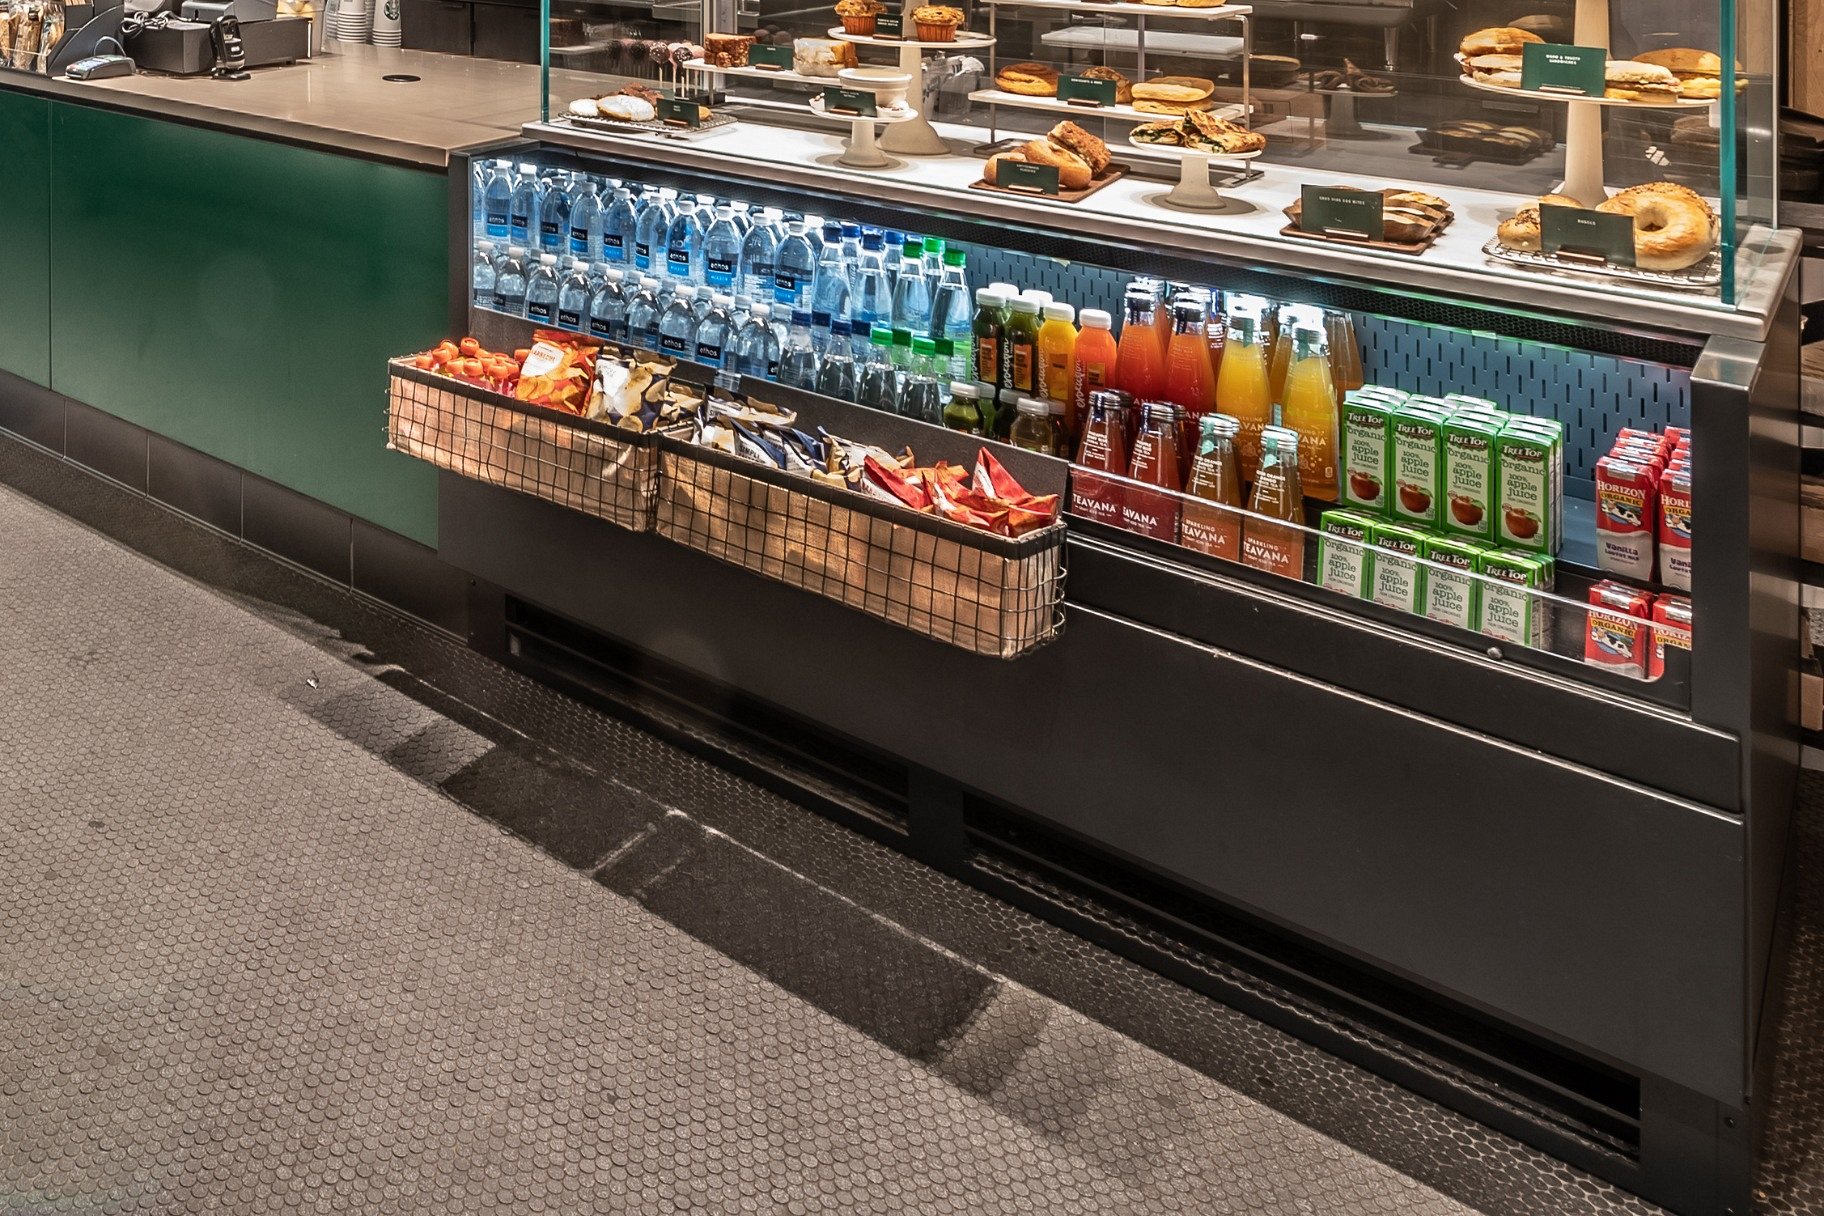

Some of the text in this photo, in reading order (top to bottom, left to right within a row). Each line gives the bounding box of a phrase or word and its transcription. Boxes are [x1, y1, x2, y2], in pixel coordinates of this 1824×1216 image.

[531, 306, 547, 314] ethos
[560, 314, 576, 322] ethos
[592, 322, 606, 331] ethos
[664, 339, 682, 348] ethos
[700, 347, 718, 357] ethos
[1347, 426, 1386, 441] organic
[1354, 439, 1370, 447] 100%
[1396, 437, 1437, 454] organic
[1352, 445, 1379, 458] apple
[1352, 452, 1379, 465] juice
[1403, 450, 1420, 459] 100%
[1448, 447, 1489, 464] organic
[1401, 456, 1429, 470] apple
[1401, 463, 1429, 477] juice
[1455, 461, 1473, 470] 100%
[1502, 459, 1545, 476] organic
[1452, 467, 1482, 481] apple
[1453, 474, 1482, 489] juice
[1509, 473, 1528, 483] 100%
[1507, 479, 1537, 494] apple
[1507, 486, 1537, 501] juice
[1597, 479, 1646, 499] HORIZON
[1073, 493, 1116, 513] TEAVANA
[1600, 492, 1642, 506] ORGANIC
[1185, 519, 1216, 532] SPARKLING
[1182, 523, 1225, 545] TEAVANA
[1247, 537, 1279, 551] SPARKLING
[1325, 540, 1364, 556] organic
[1244, 541, 1289, 564] TEAVANA
[1331, 553, 1347, 562] 100%
[1328, 559, 1356, 572] apple
[1376, 554, 1417, 571] organic
[1328, 567, 1356, 582] juice
[1381, 567, 1399, 576] 100%
[1429, 568, 1471, 586] organic
[1379, 572, 1408, 587] apple
[1435, 582, 1453, 591] 100%
[1379, 582, 1408, 597] juice
[1432, 587, 1463, 603] apple
[1484, 583, 1527, 601] organic
[1433, 597, 1463, 612] juice
[1491, 597, 1509, 606] 100%
[1488, 603, 1519, 618] apple
[1488, 611, 1519, 628] juice
[1592, 619, 1634, 636] ORGANIC
